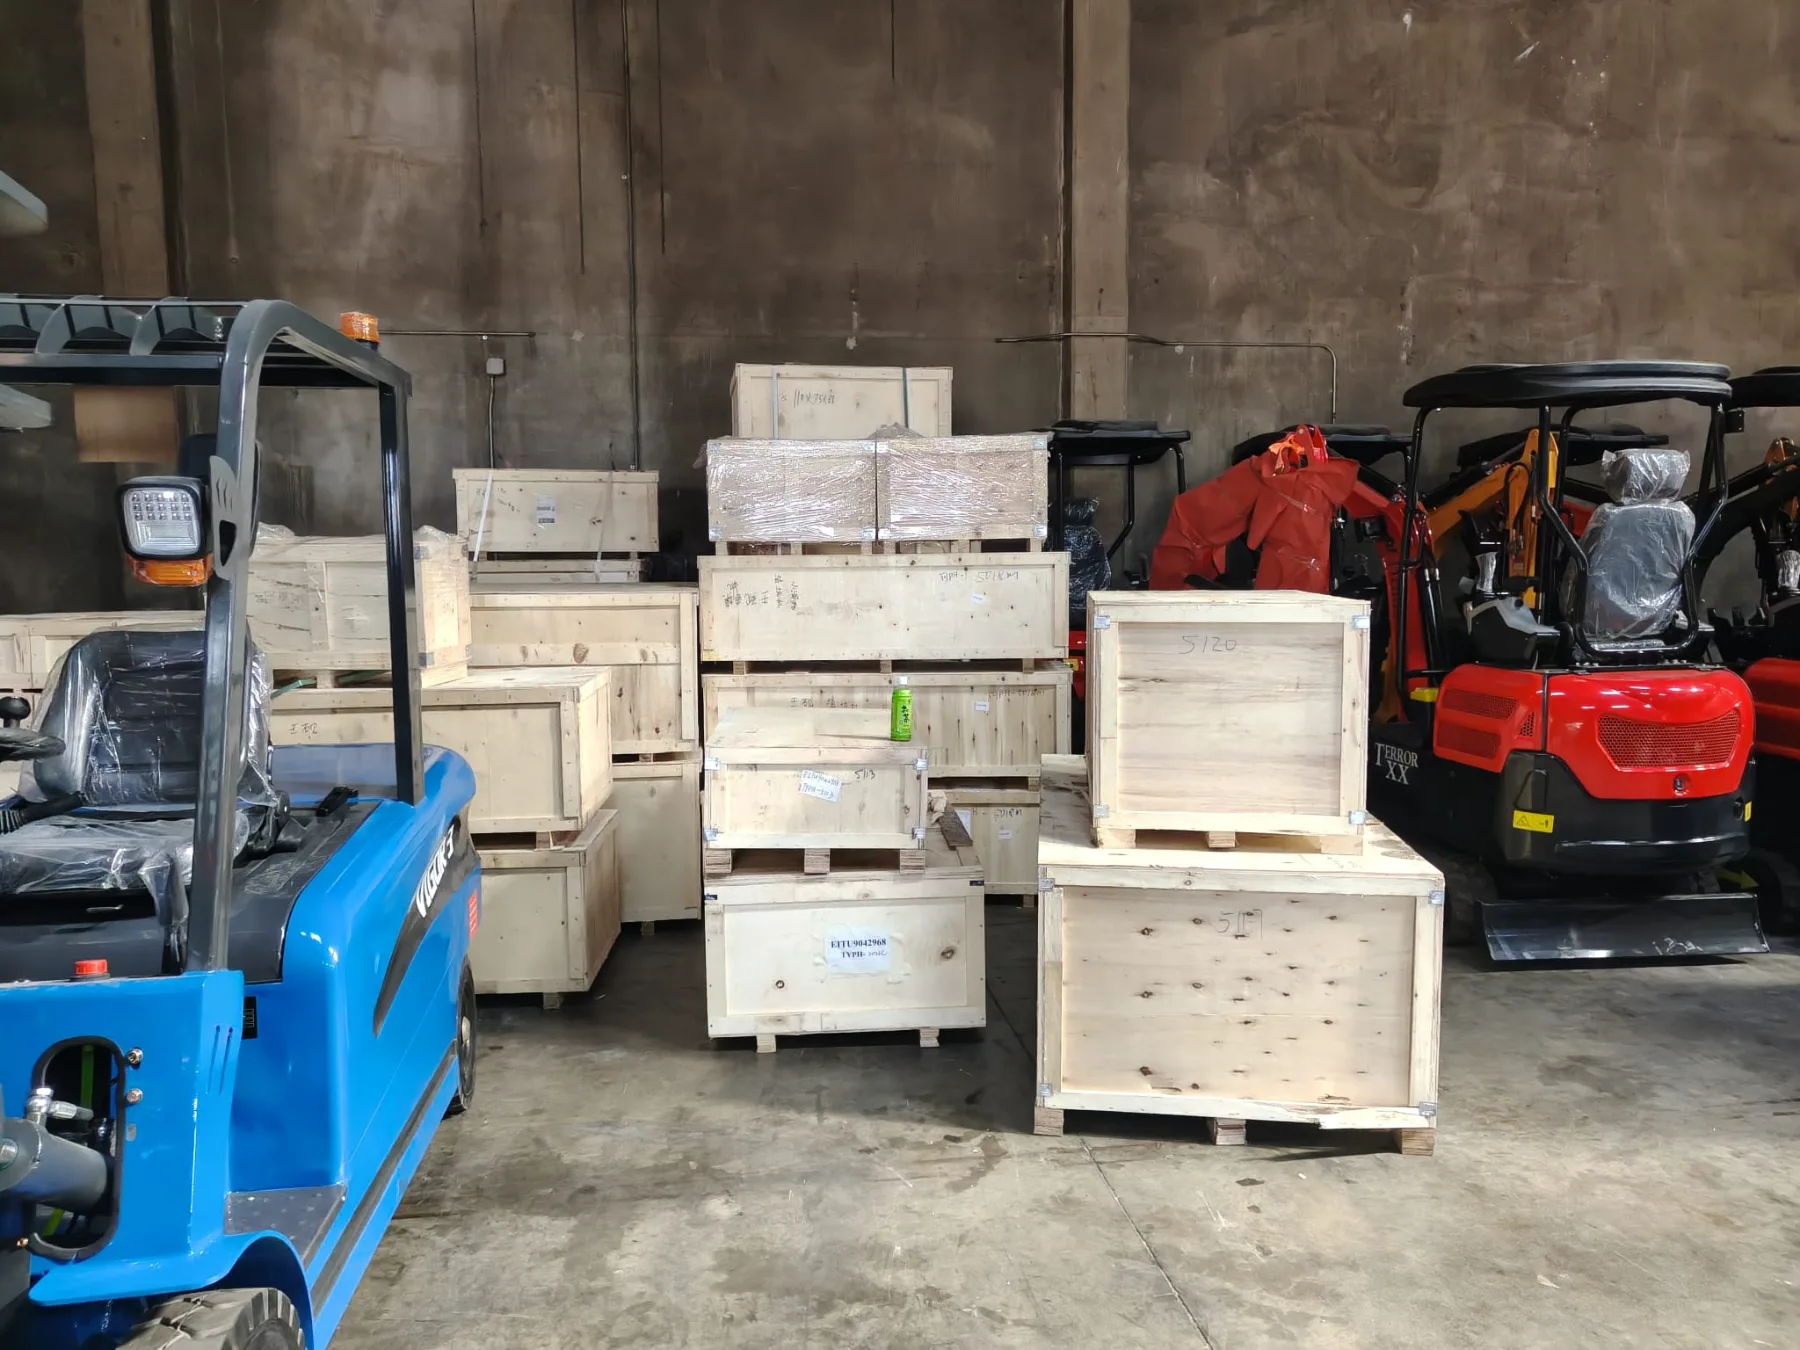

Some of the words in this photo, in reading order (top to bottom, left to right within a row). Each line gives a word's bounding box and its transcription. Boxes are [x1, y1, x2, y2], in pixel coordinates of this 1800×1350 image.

[1178, 635, 1238, 654] 5120
[1375, 742, 1419, 768] TERROR
[854, 768, 876, 780] 5113
[1385, 760, 1409, 785] XX
[830, 938, 887, 949] EITU9042968
